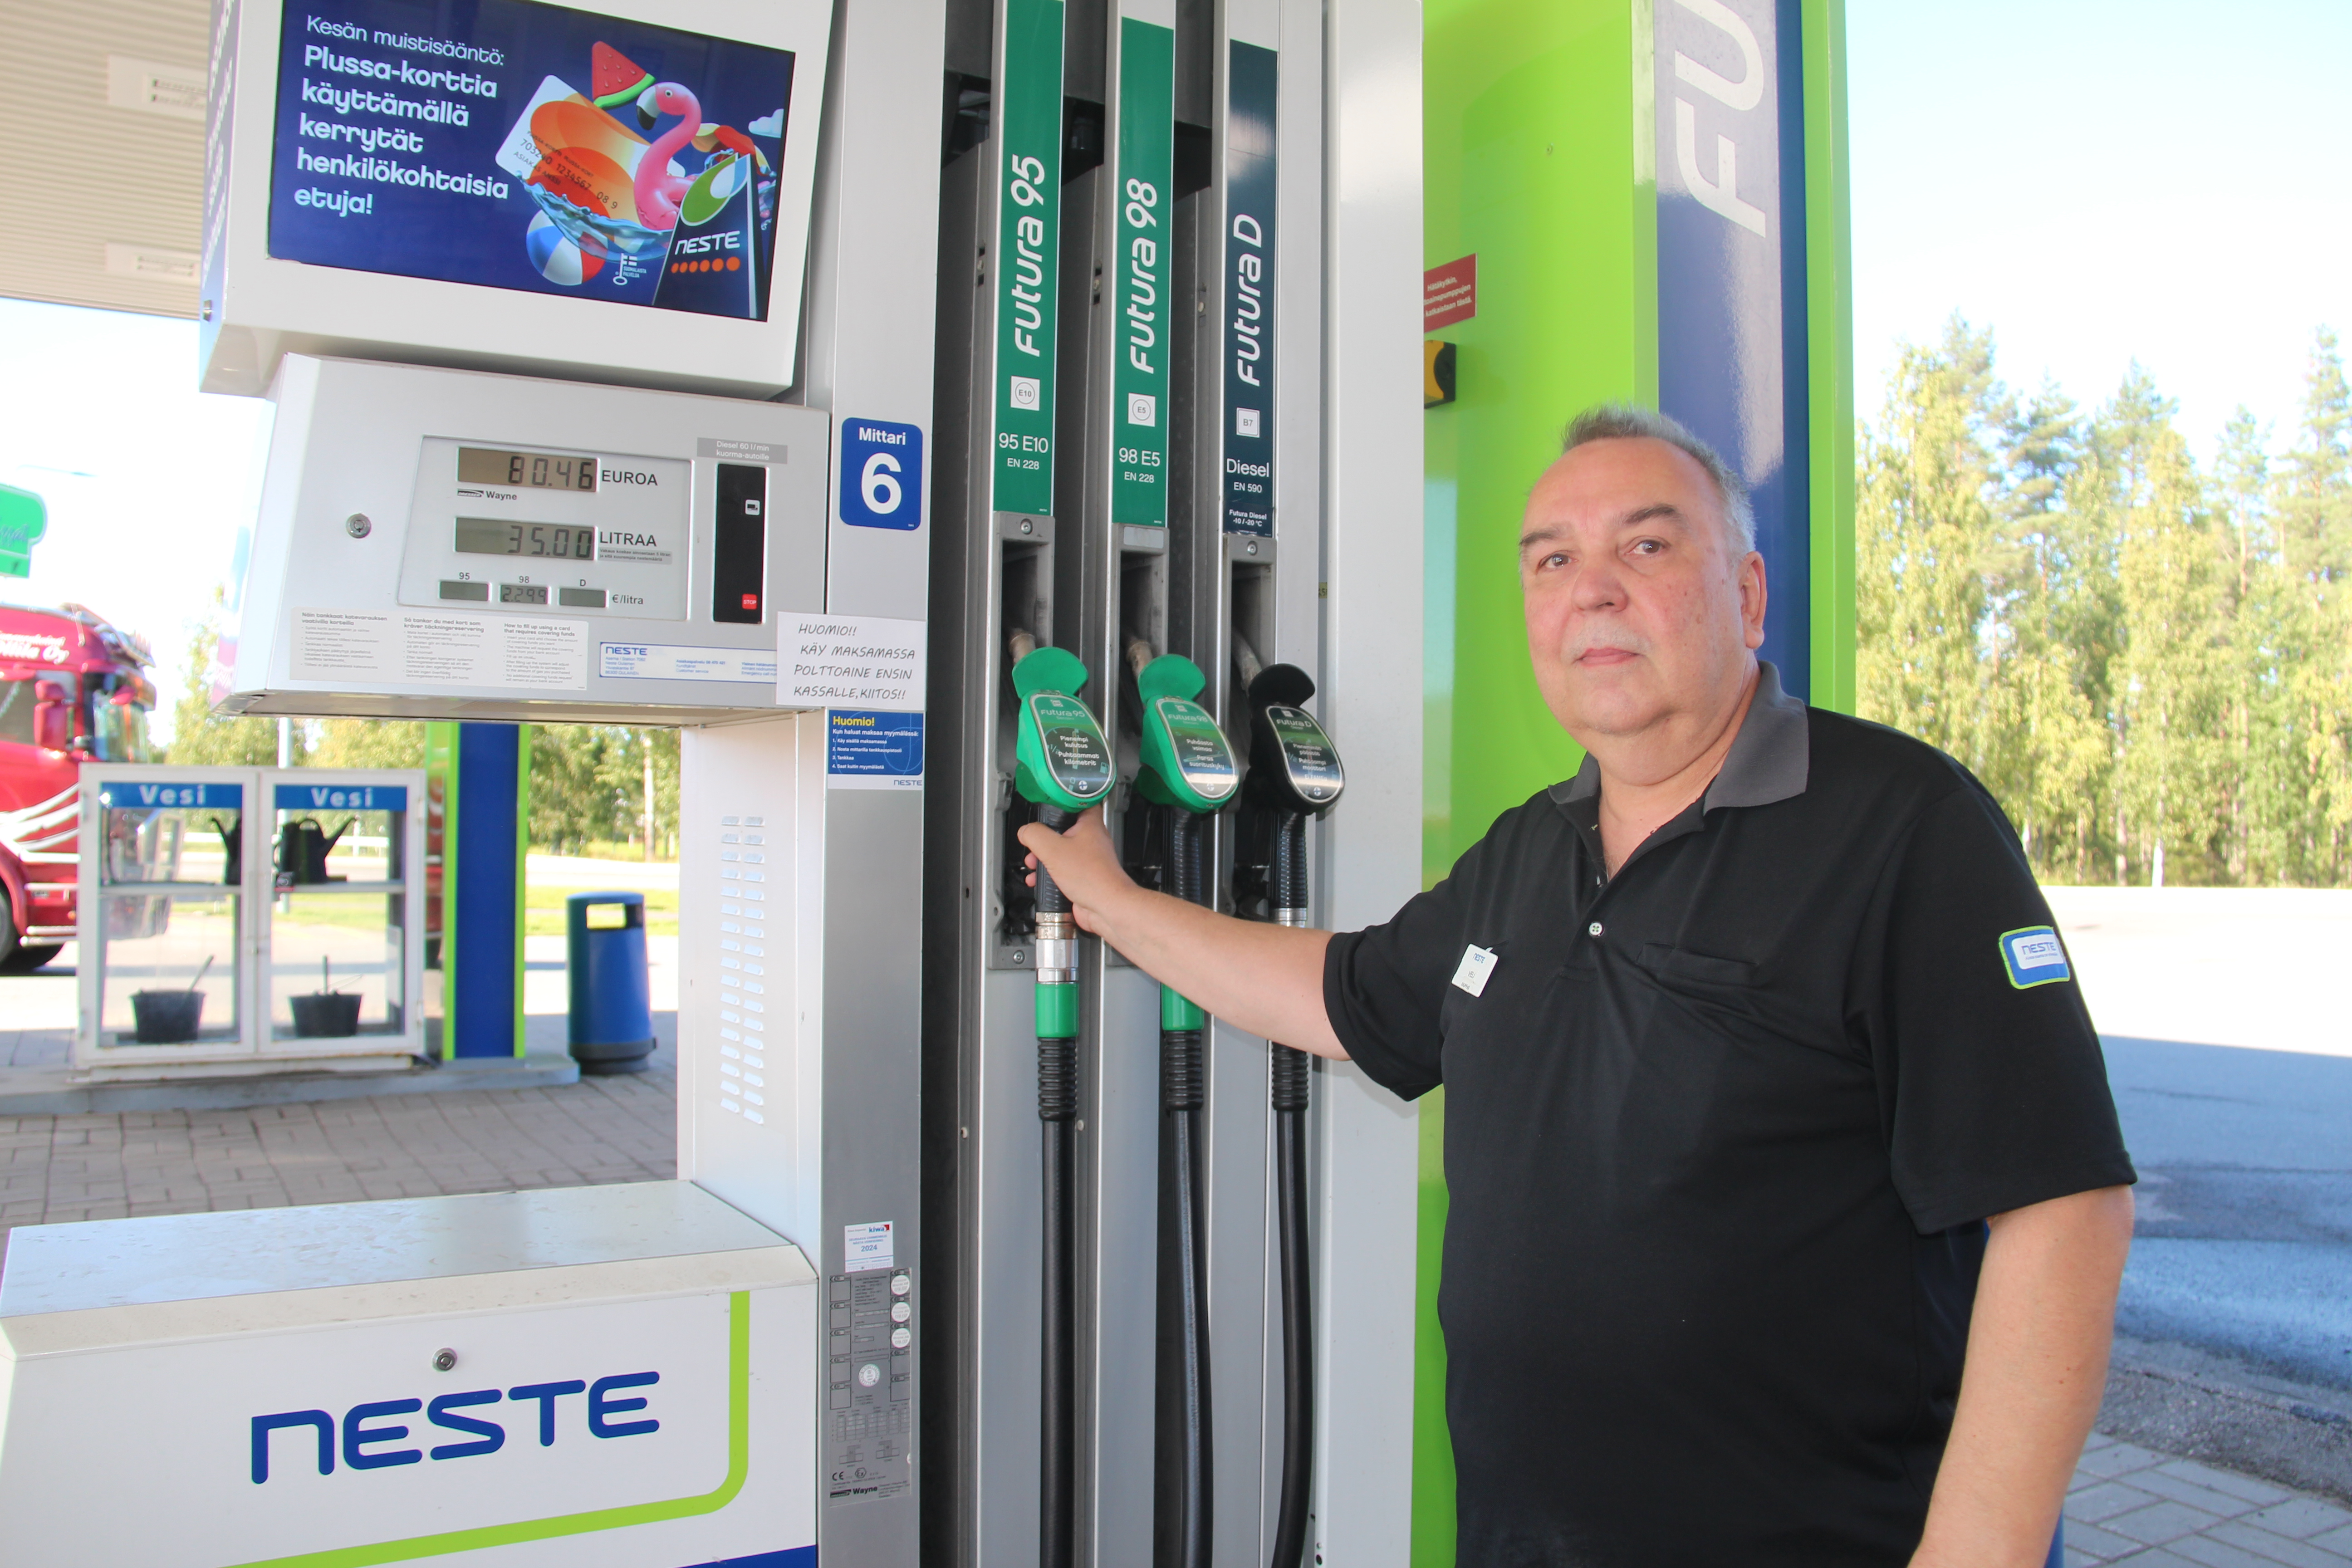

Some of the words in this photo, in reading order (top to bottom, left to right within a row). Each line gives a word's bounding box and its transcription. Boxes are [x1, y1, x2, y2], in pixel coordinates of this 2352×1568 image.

[307, 15, 367, 41] Kesän
[374, 30, 505, 66] muistisääntö:
[304, 44, 497, 98] Plussa-korttia
[302, 78, 469, 127] käyttämällä
[299, 112, 423, 153] kerrytät
[297, 146, 509, 199] henkilökohtaisia
[1010, 154, 1044, 206] 95
[294, 187, 373, 217] etuja!
[1126, 178, 1157, 228] 98
[1233, 214, 1262, 248] D
[675, 230, 740, 255] NESTE
[1011, 216, 1043, 357] Futura
[1127, 237, 1156, 374] Futura
[1234, 253, 1261, 387] Futura
[1243, 418, 1253, 426] B7
[716, 441, 738, 449] Diesel
[859, 427, 906, 446] Mittari
[999, 432, 1019, 450] 95
[1023, 436, 1049, 453] E10
[716, 450, 769, 460] kuorma-autoille
[1007, 458, 1020, 468] EN
[1023, 460, 1039, 470] 228
[1119, 447, 1137, 464] 98
[1142, 451, 1160, 466] E5
[508, 455, 593, 490] 80.46
[1124, 471, 1136, 481] EN
[1139, 473, 1154, 483] 228
[1227, 458, 1269, 477] Diesel
[601, 470, 658, 486] EUROA
[862, 452, 902, 514] 6
[1234, 482, 1245, 491] EN
[1248, 483, 1262, 493] 590
[485, 490, 517, 501] Wayne
[1229, 509, 1248, 517] Futura
[507, 524, 593, 559] 35.00
[599, 531, 657, 547] LITRAA
[459, 572, 470, 581] 95
[519, 575, 530, 583] 98
[502, 587, 547, 603] 2.299
[611, 594, 644, 605] €/litra
[798, 623, 857, 636] HUOMIO!!
[606, 647, 647, 655] NESTE
[800, 642, 827, 657] KÄY
[831, 646, 916, 659] MAKSAMASSA
[794, 664, 872, 678] POLTTOAINE
[876, 668, 912, 680] ENSIN
[833, 716, 875, 726] Huomio!
[139, 784, 207, 805] Vesi
[310, 787, 374, 808] Vesi
[2021, 942, 2057, 955] NESTE
[250, 1371, 660, 1485] NESTE
[853, 1485, 878, 1494] Wayne
